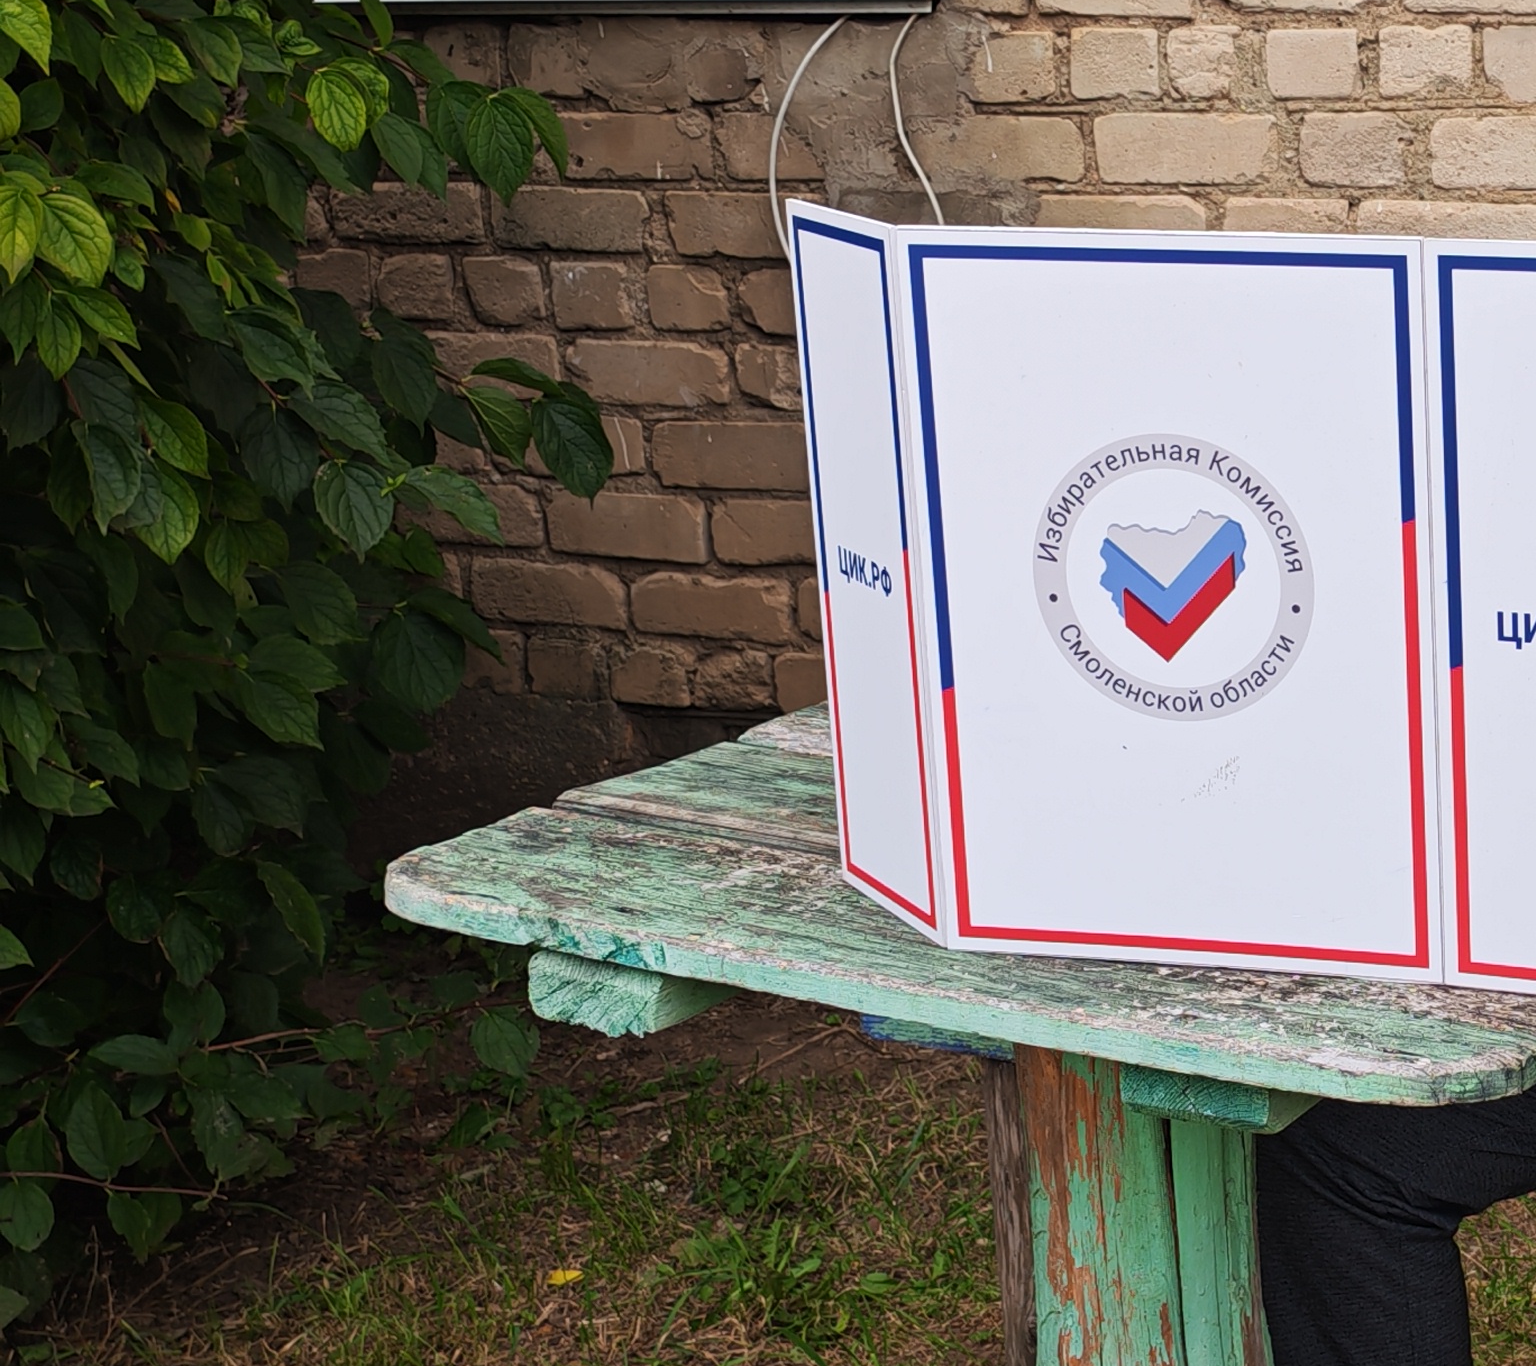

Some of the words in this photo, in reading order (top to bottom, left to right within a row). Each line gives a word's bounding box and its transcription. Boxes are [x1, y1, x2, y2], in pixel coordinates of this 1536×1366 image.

[1037, 443, 1201, 564] Избирательная
[1208, 450, 1304, 574] Комиссия
[837, 545, 893, 598] ЦИК.РФ
[1060, 623, 1204, 713] Смоленской
[1210, 633, 1296, 709] области
